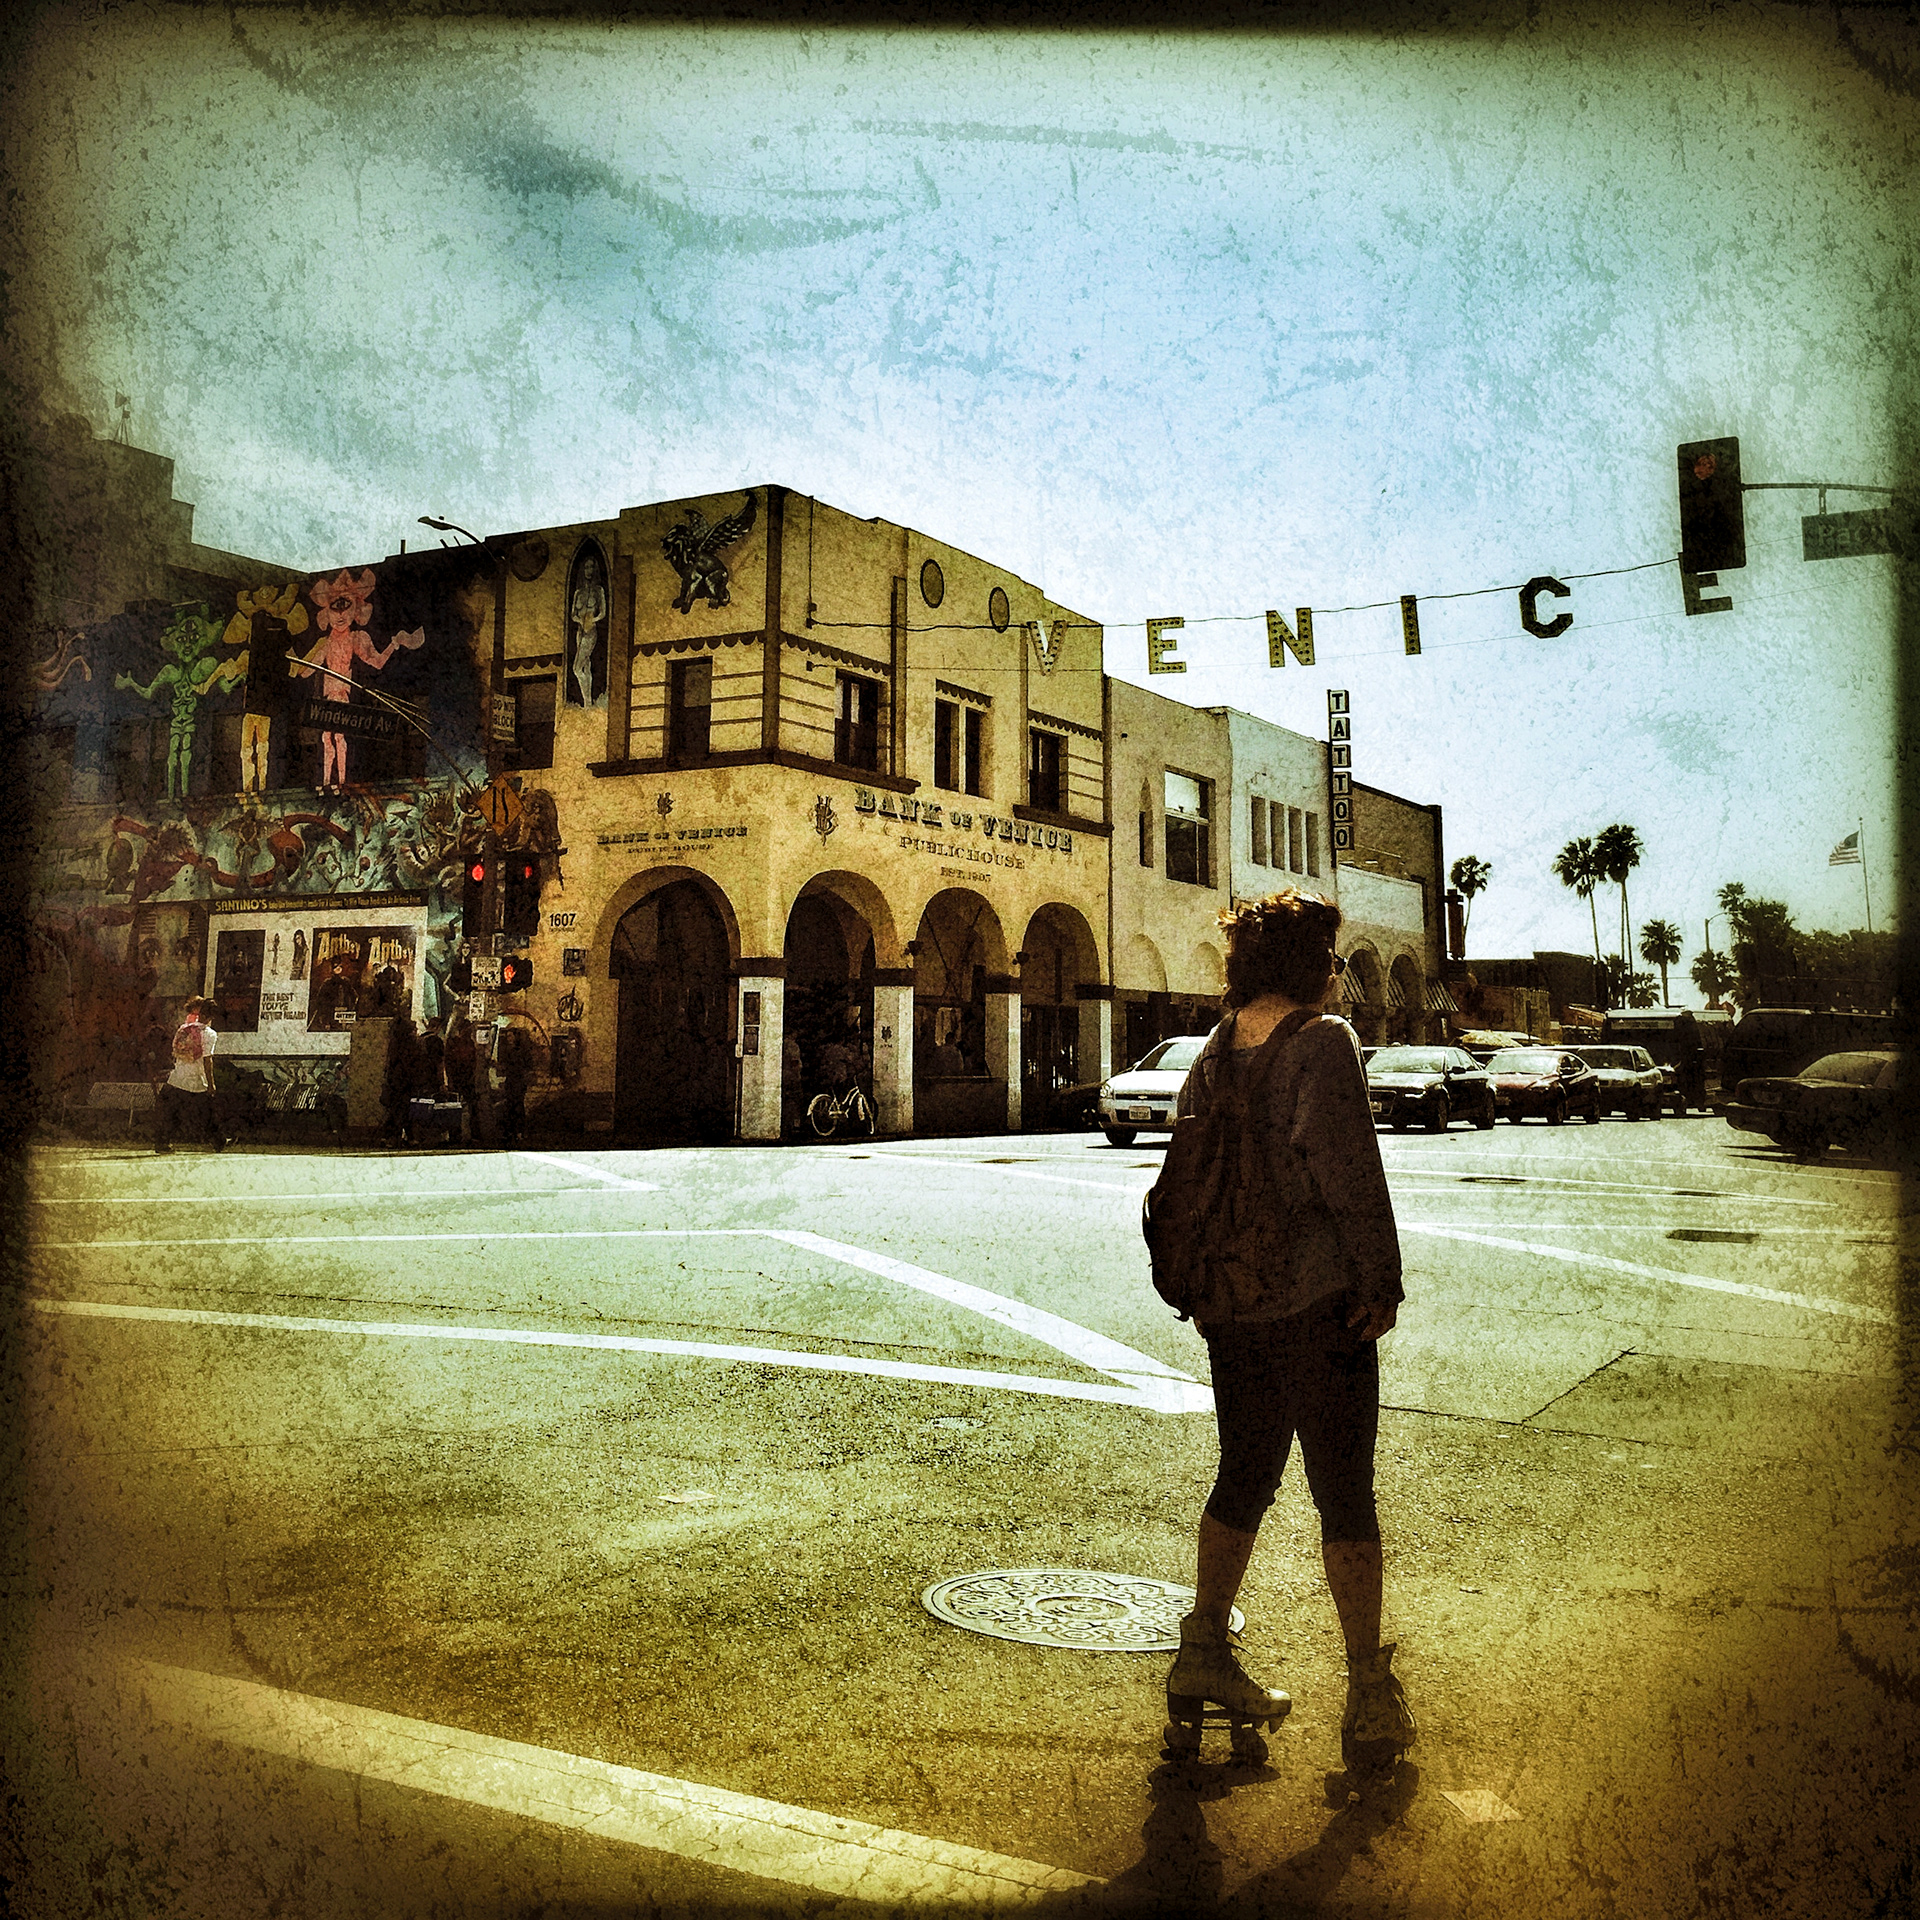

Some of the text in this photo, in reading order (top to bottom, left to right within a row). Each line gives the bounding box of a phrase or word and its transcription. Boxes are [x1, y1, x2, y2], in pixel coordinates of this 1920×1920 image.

[1026, 552, 1734, 676] VENICE
[310, 703, 373, 730] Windward
[1331, 692, 1348, 847] TATTOO
[674, 826, 748, 841] VENICE
[855, 788, 943, 828] BANK
[979, 813, 1074, 853] VENICE
[899, 836, 1026, 870] PUBLIC HOUSE
[214, 899, 268, 912] SANTINO'S
[549, 912, 576, 928] 1607
